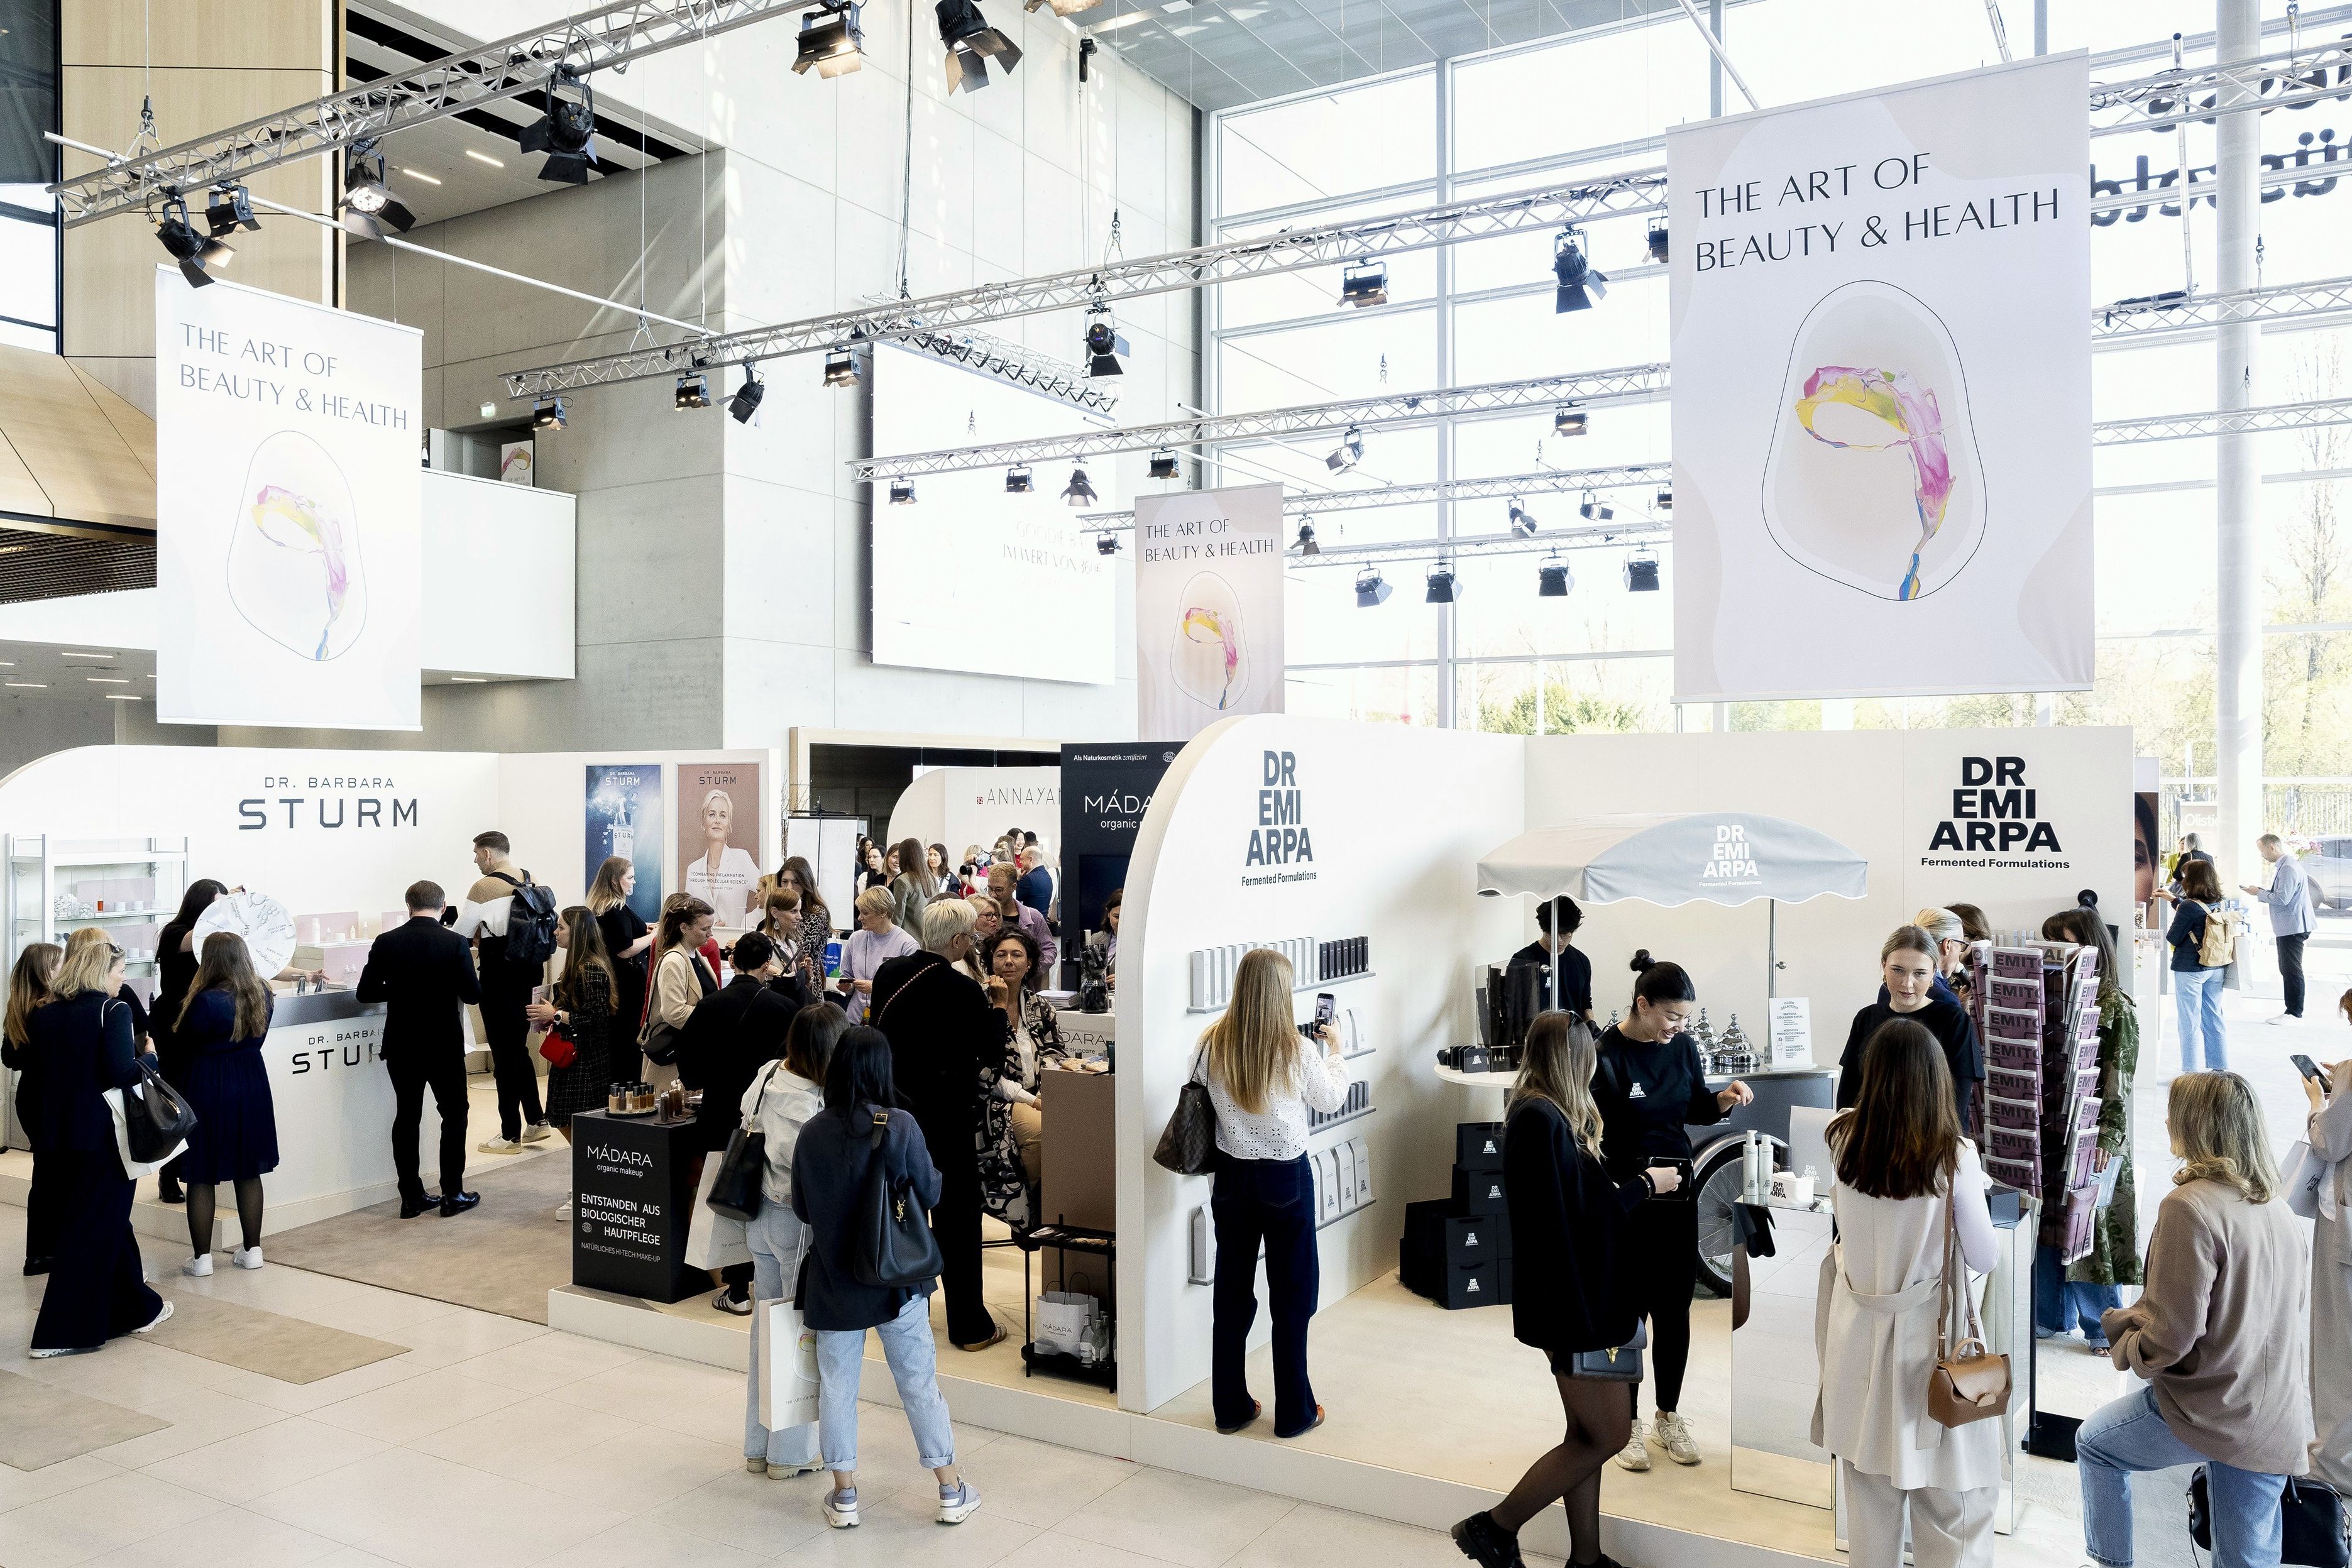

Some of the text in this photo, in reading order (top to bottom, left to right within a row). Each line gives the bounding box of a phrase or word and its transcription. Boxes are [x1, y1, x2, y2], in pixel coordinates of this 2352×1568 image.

[1695, 153, 1930, 218] THE ART OF
[1697, 188, 2058, 271] BEAUTY & HEALTH
[180, 322, 338, 377] THE ART OF
[180, 363, 407, 430] BEAUTY & HEALTH
[1145, 518, 1230, 539] THE ART OF
[1145, 539, 1273, 562] BEAUTY & HEALTH
[1263, 750, 1296, 786] DR
[1962, 756, 2026, 786] DR
[265, 777, 395, 788] DR. BARBARA
[605, 777, 640, 786] STURM
[699, 776, 737, 785] STURM
[986, 787, 1062, 805] ANNAYA
[1953, 789, 2036, 819] EMI
[239, 798, 417, 830] STURM
[1259, 789, 1301, 826] EMI
[1101, 819, 1137, 830] organic
[1717, 825, 1745, 842] DR
[1928, 821, 2062, 852] ARPA
[1245, 828, 1313, 867] ARPA
[1713, 842, 1750, 860] EMI
[1702, 860, 1759, 878] ARPA
[1921, 858, 2070, 869] Fermented Formulations
[1241, 870, 1317, 887] Fermented Formulations
[309, 1036, 329, 1045] DR.
[587, 1143, 653, 1168] MÁDARA
[596, 1164, 643, 1178] organic makeup
[581, 1193, 660, 1215] ENTSTANDEN AUS
[1770, 1191, 1786, 1199] ARPA
[581, 1208, 646, 1228] BIOLOGISCHER
[604, 1226, 661, 1246] HAUTPFLEGE
[581, 1242, 661, 1263] NATÜRLICHES HI-TECH MAKE-UP
[1042, 1323, 1072, 1334] MÁDARA
